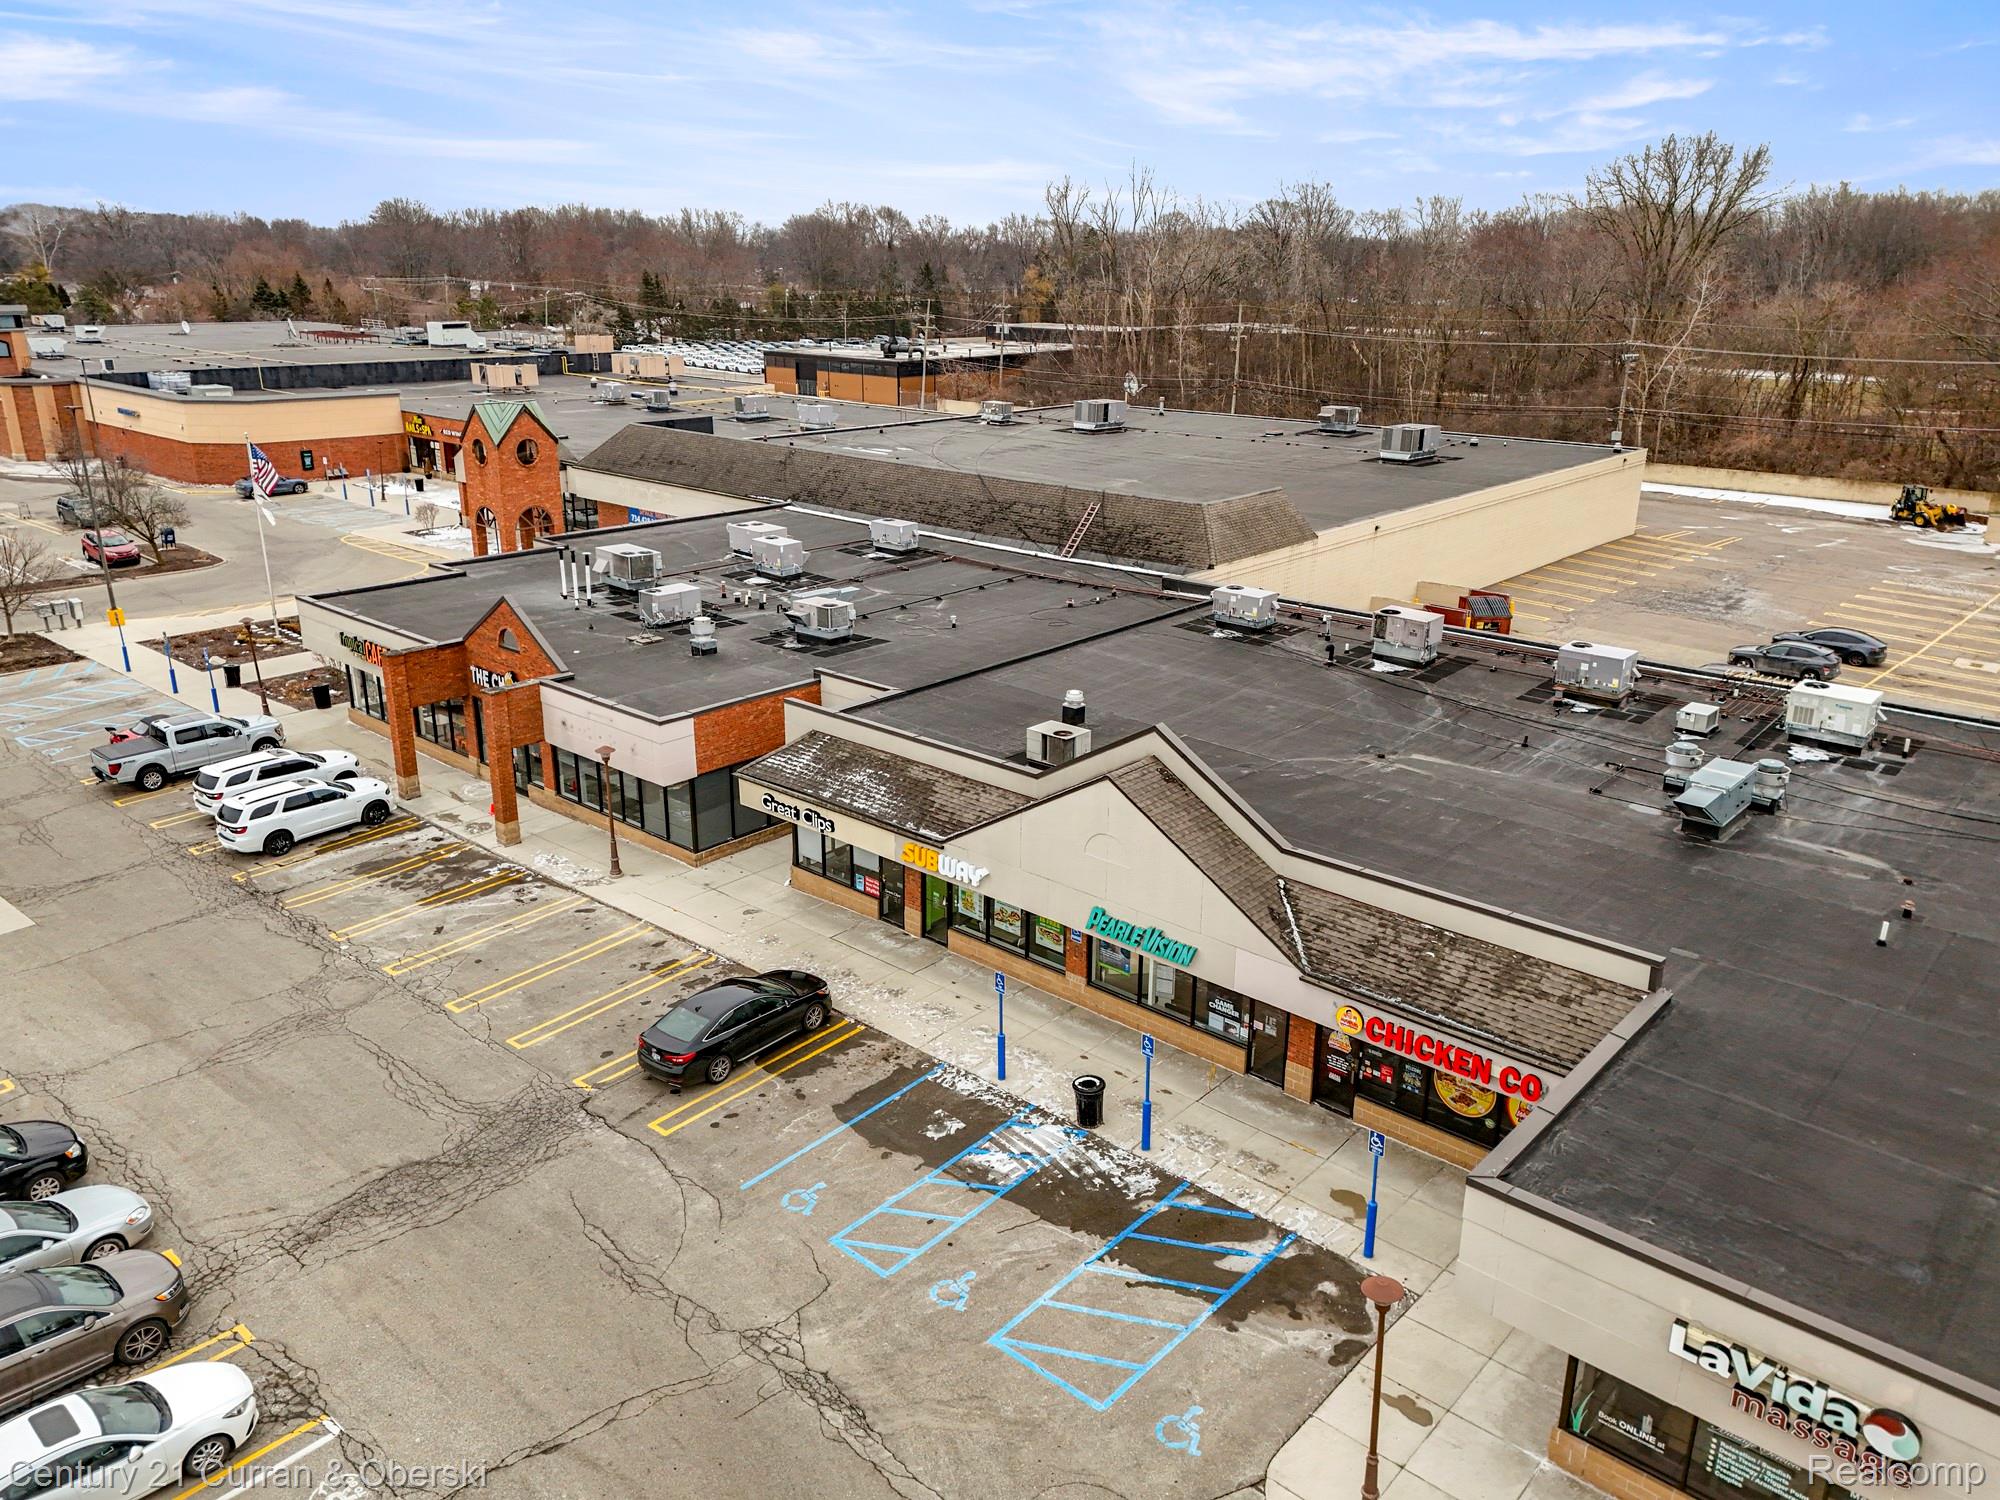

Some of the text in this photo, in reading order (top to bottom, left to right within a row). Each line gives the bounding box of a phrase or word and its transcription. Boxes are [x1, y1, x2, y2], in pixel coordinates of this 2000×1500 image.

[364, 640, 390, 666] CAF
[470, 665, 490, 688] THE
[761, 794, 835, 834] Great Clips
[902, 842, 990, 887] SUBWAY
[1086, 906, 1144, 948] PEARLE
[1142, 926, 1198, 967] VISION
[1208, 1001, 1240, 1018] CHANGER
[1214, 998, 1234, 1010] GAME
[1365, 1016, 1493, 1085] CHICKEN
[1499, 1066, 1542, 1102] CO
[1669, 1318, 1860, 1438] LaVida
[1598, 1410, 1618, 1425] Book
[1618, 1420, 1657, 1445] ONLINE
[1714, 1470, 1743, 1488] Couples
[1715, 1464, 1744, 1483] Prenatal
[1716, 1459, 1729, 1469] Hot
[1729, 1465, 1751, 1480] Stone
[1718, 1453, 1757, 1478] Reflexology
[1763, 1474, 1789, 1492] Trigger
[1789, 1488, 1810, 1500] Point
[1719, 1446, 1737, 1460] Deep
[1738, 1456, 1761, 1472] Tissue
[1765, 1470, 1790, 1487] Sports
[1720, 1441, 1757, 1463] Relaxation
[1761, 1461, 1792, 1481] Swedish
